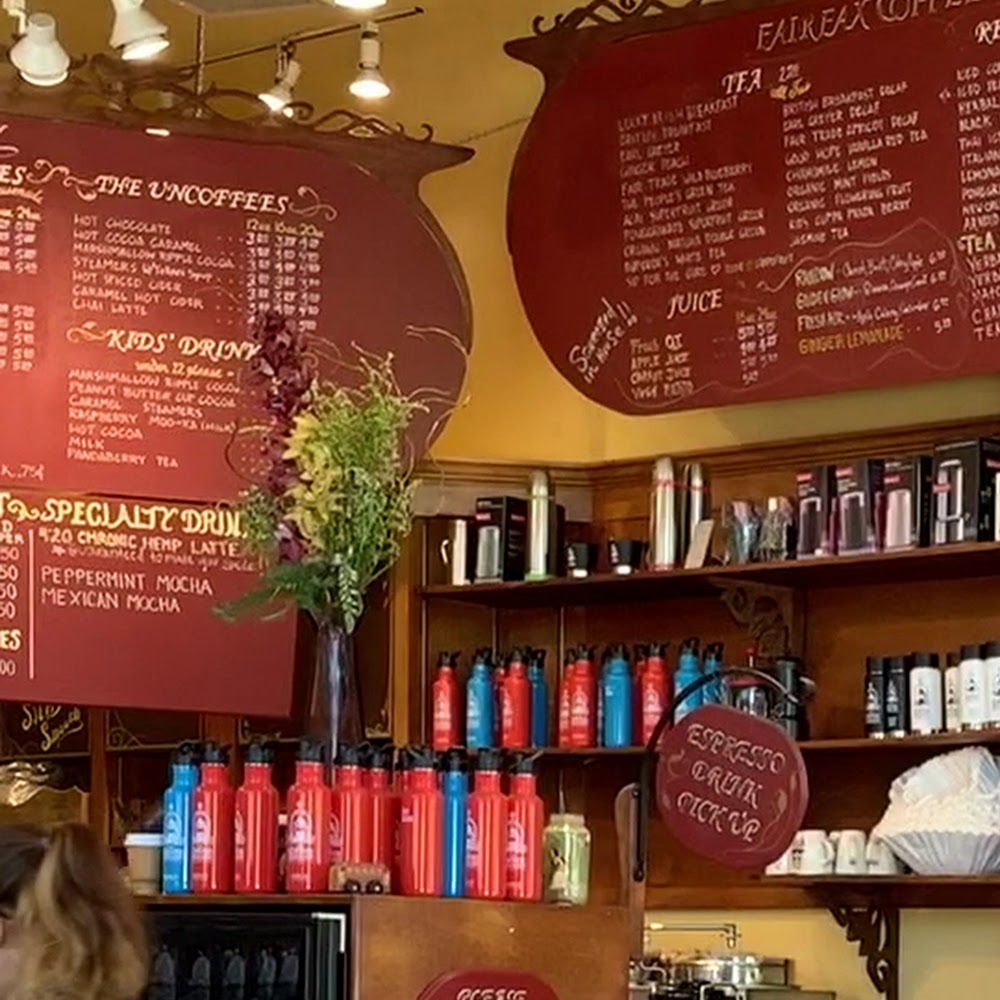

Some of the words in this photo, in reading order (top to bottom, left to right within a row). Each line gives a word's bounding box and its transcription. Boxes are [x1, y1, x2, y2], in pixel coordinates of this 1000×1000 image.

[721, 68, 762, 96] TEA
[97, 174, 143, 201] THE
[149, 180, 289, 215] UNCOFFEES
[960, 231, 997, 256] TEA
[666, 288, 724, 320] JUICE
[179, 336, 263, 363] DRINK
[69, 370, 160, 387] MARSHMALLOW
[68, 436, 106, 451] MILK
[69, 424, 96, 439] HOT
[100, 427, 144, 441] COCOA
[156, 455, 180, 469] TEA
[40, 498, 180, 533] SPECIALTY
[181, 507, 248, 540] DRIN
[142, 535, 184, 552] HEMP
[41, 565, 147, 591] PEPPERMINT
[156, 574, 213, 596] MOCHA
[41, 587, 119, 609] MEXICAN
[127, 593, 181, 613] MOCHA
[687, 722, 787, 775] ESPRESSO
